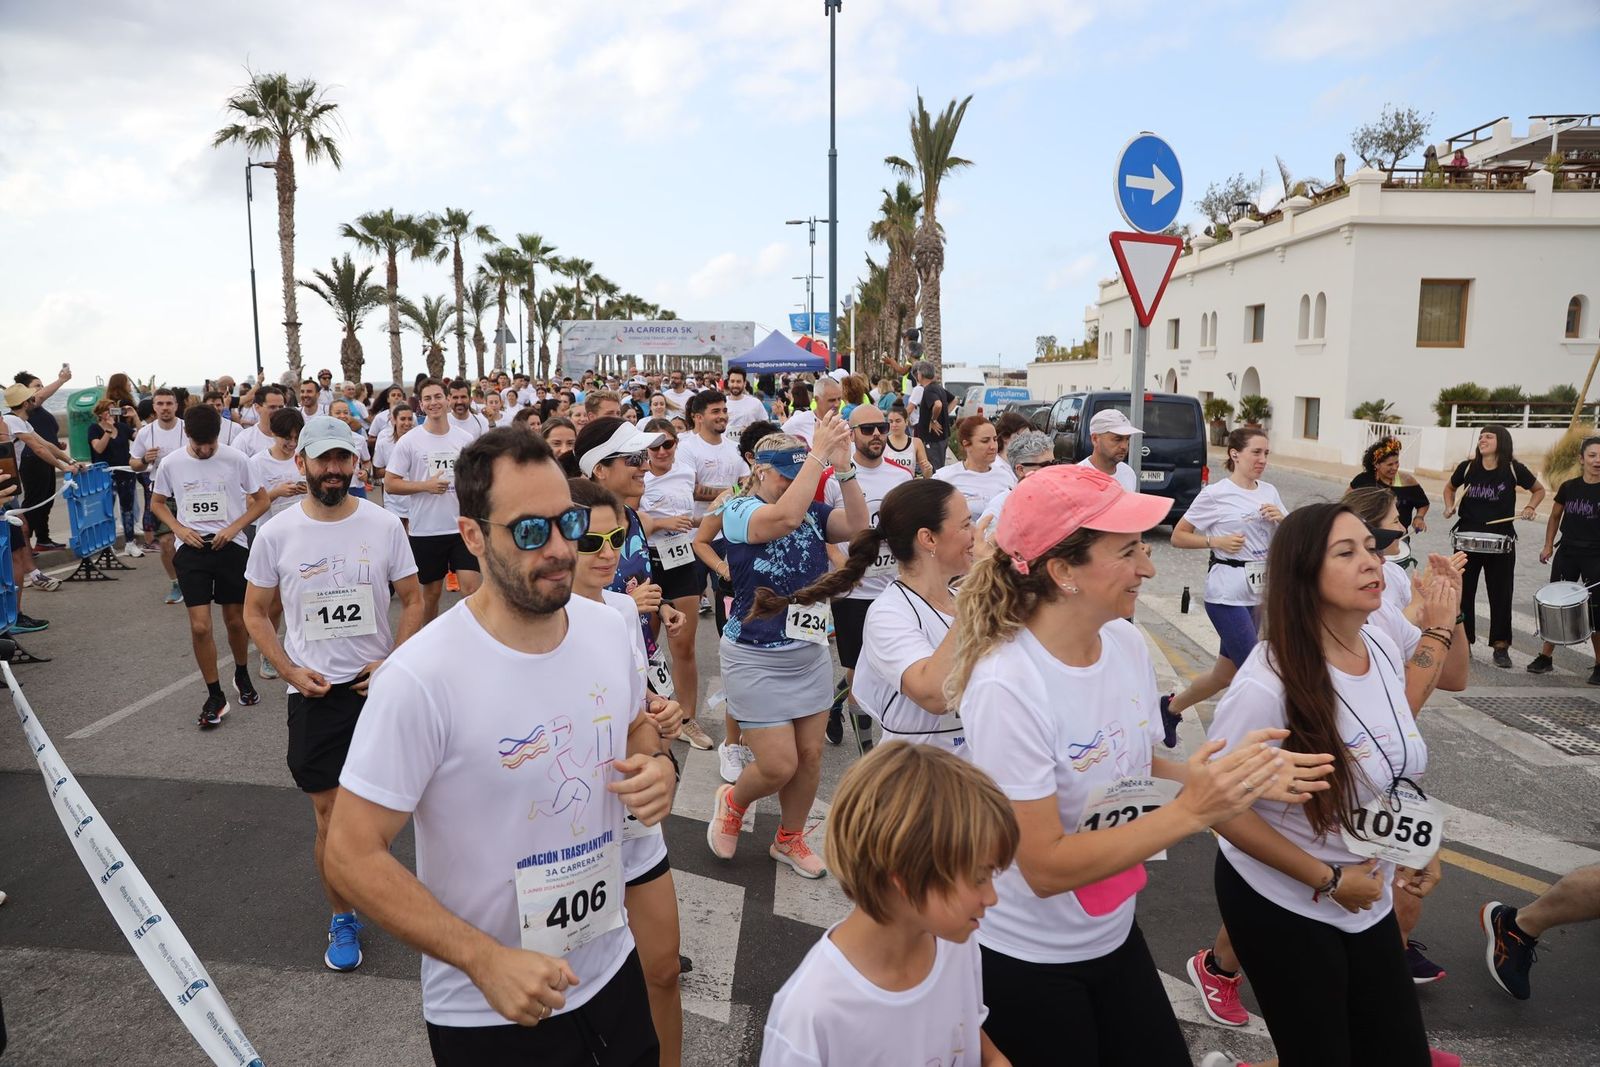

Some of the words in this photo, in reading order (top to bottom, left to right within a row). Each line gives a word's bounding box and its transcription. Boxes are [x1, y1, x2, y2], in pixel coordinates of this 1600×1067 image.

[636, 326, 678, 334] CARRERA
[435, 460, 455, 469] 713
[193, 502, 218, 513] 595
[668, 544, 689, 558] 151
[874, 554, 896, 567] 075
[318, 604, 361, 624] 142
[792, 612, 826, 632] 1234
[1352, 807, 1433, 847] 1058
[561, 836, 604, 861] TRASPLANT
[546, 869, 558, 877] 3A
[560, 857, 595, 874] CARRERA
[596, 852, 604, 861] 5K
[547, 880, 606, 929] 406
